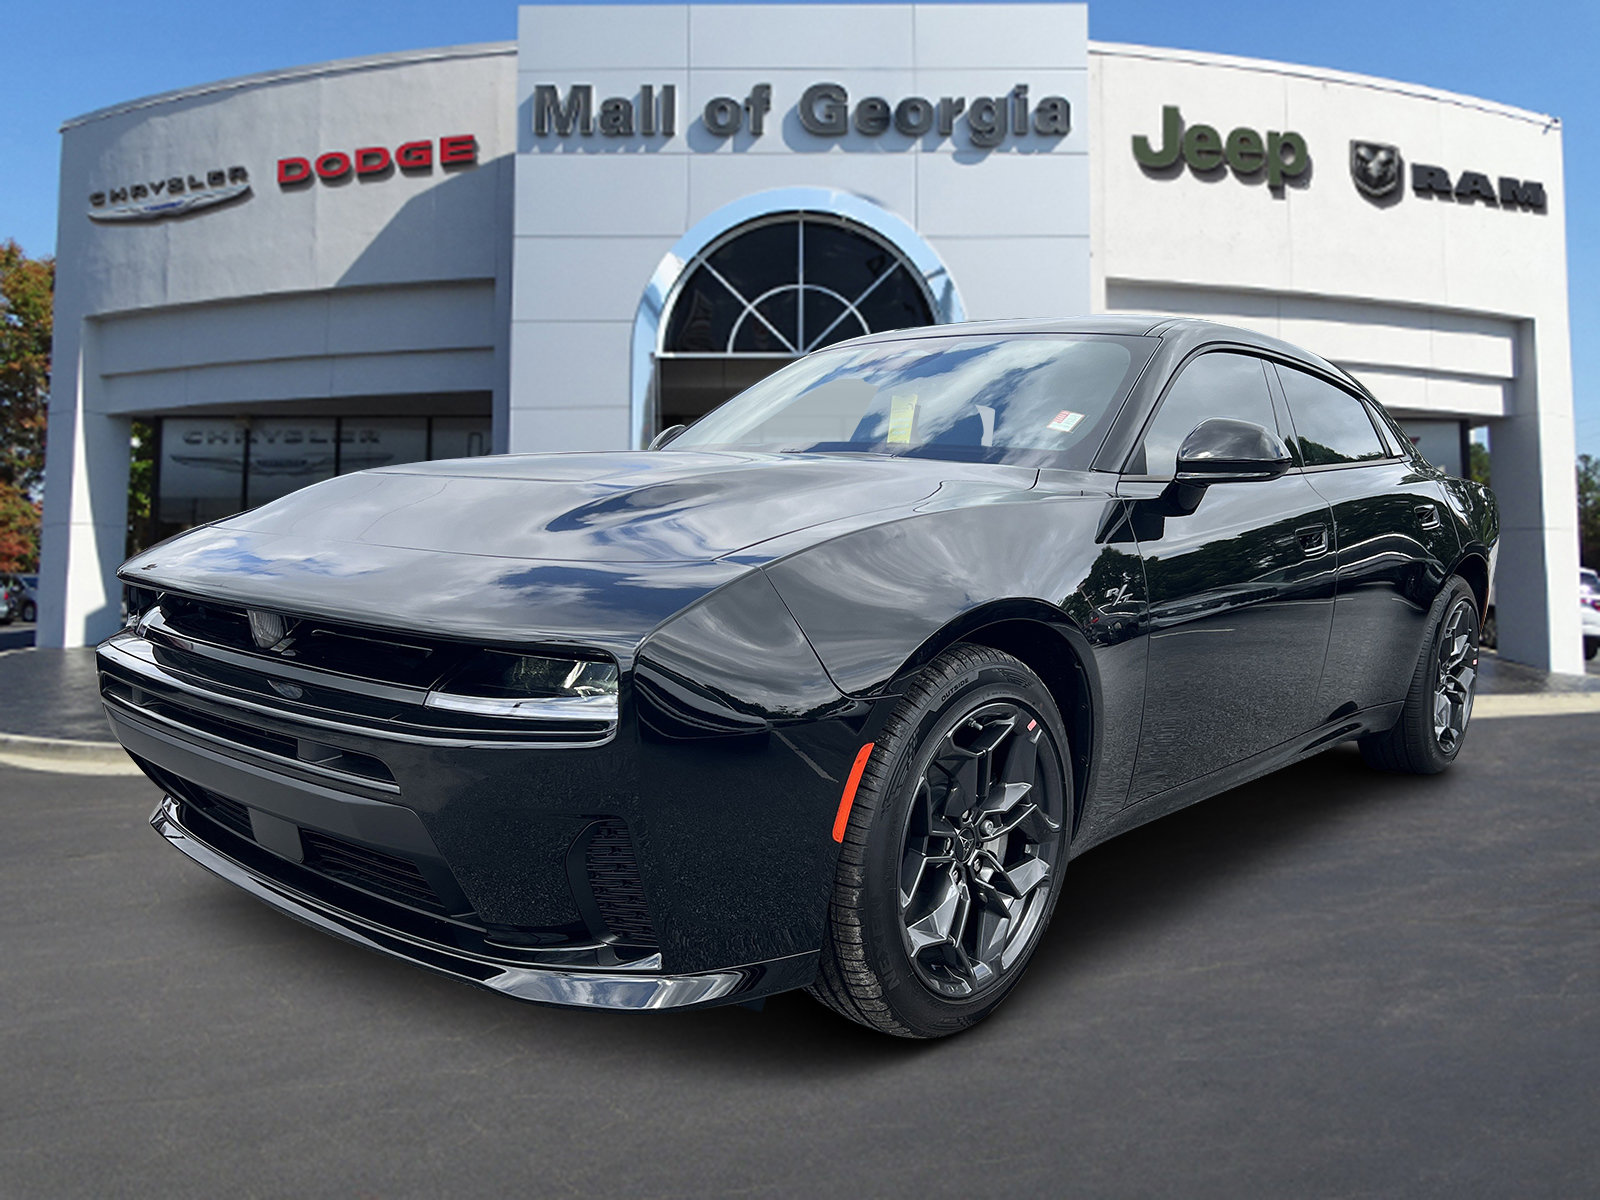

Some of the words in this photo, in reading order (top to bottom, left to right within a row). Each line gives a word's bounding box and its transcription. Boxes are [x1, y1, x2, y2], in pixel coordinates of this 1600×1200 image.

[533, 84, 677, 137] Mall
[702, 83, 772, 136] of
[799, 82, 1072, 148] Georgia
[277, 134, 476, 188] DODGE
[1131, 105, 1310, 194] Jeep
[89, 165, 249, 208] CHRYSLER
[1411, 162, 1547, 214] RAM
[1105, 583, 1134, 607] R/T
[940, 677, 970, 703] OUTSIDE
